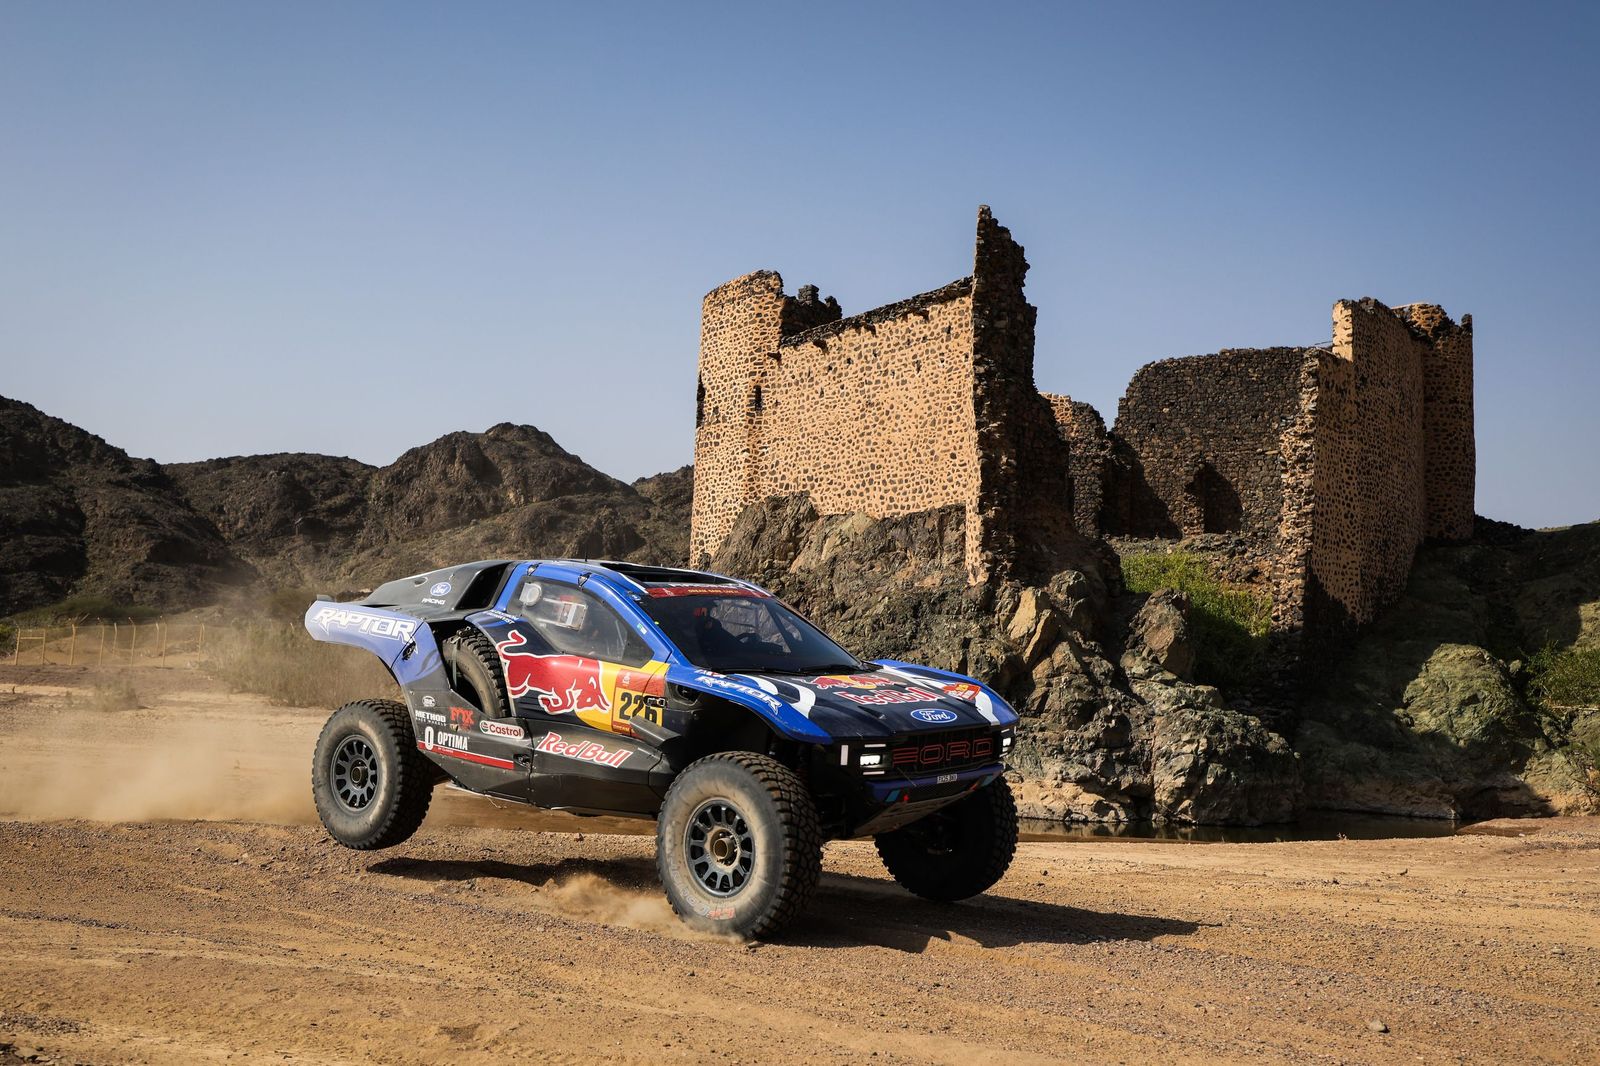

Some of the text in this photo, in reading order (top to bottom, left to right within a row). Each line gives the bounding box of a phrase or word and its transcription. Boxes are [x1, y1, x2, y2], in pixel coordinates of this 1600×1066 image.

[313, 608, 418, 654] RAPTOR
[693, 676, 783, 715] RAPTOR
[415, 710, 446, 723] METHOD
[449, 706, 475, 728] FOX
[917, 709, 953, 722] Ford
[437, 731, 468, 750] OPTIMA
[489, 725, 522, 737] Castrol
[892, 738, 993, 767] FORD
